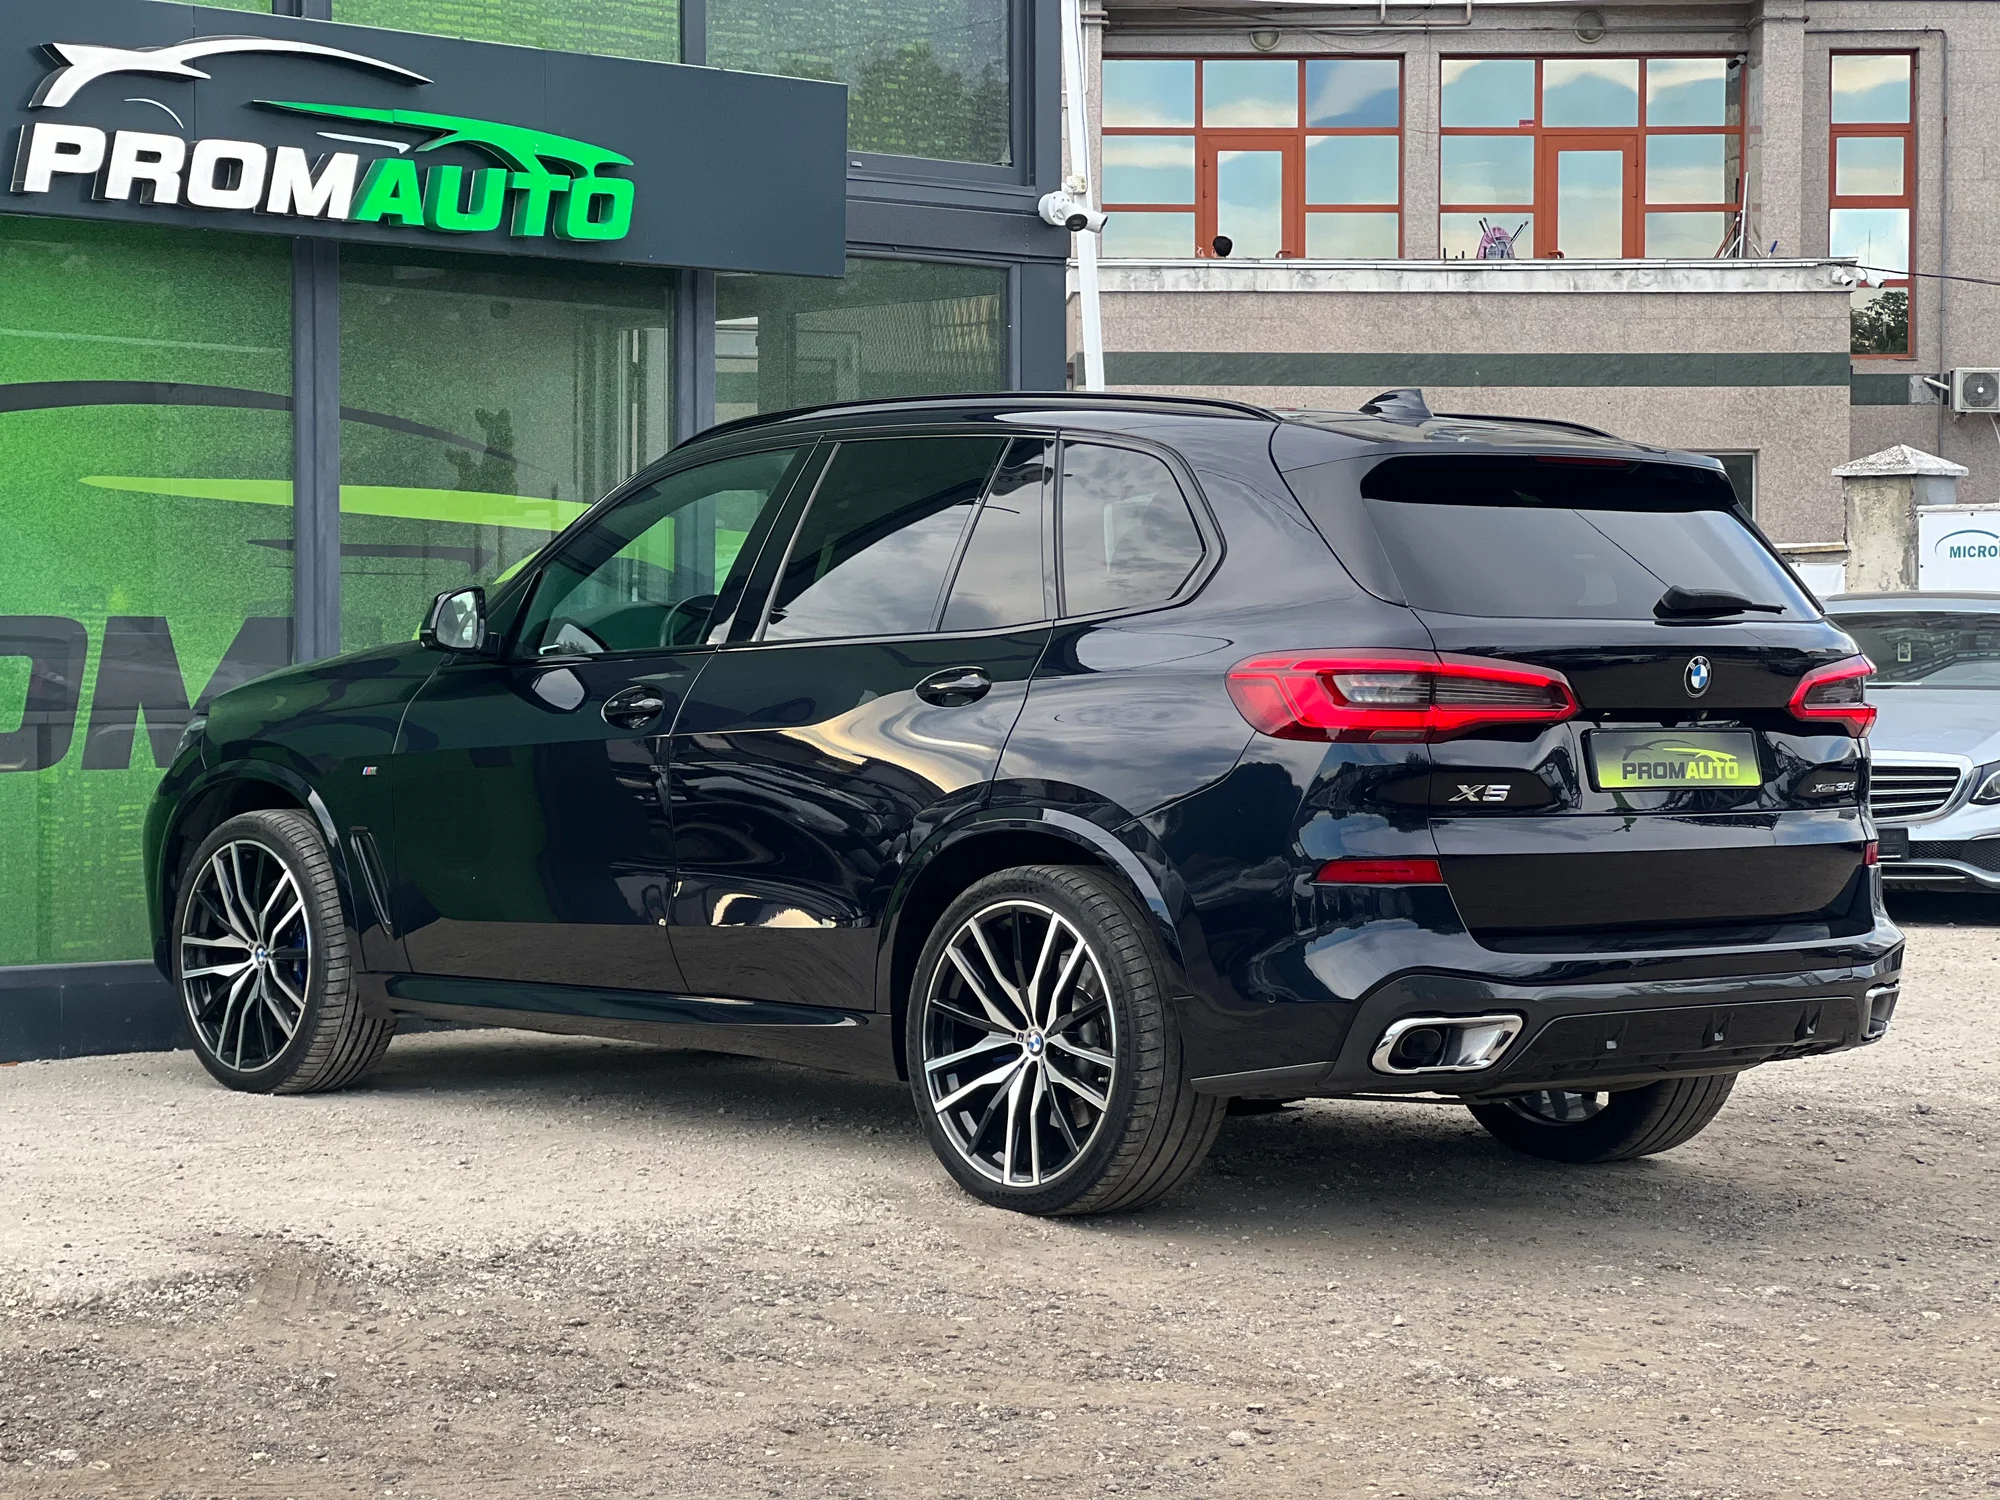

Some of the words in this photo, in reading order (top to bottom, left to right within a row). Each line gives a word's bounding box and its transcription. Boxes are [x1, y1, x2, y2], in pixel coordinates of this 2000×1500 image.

[11, 121, 635, 241] PROMAUTO
[1949, 545, 2000, 558] MICRO
[1622, 761, 1739, 780] PROMAUTO
[1447, 784, 1511, 802] X5
